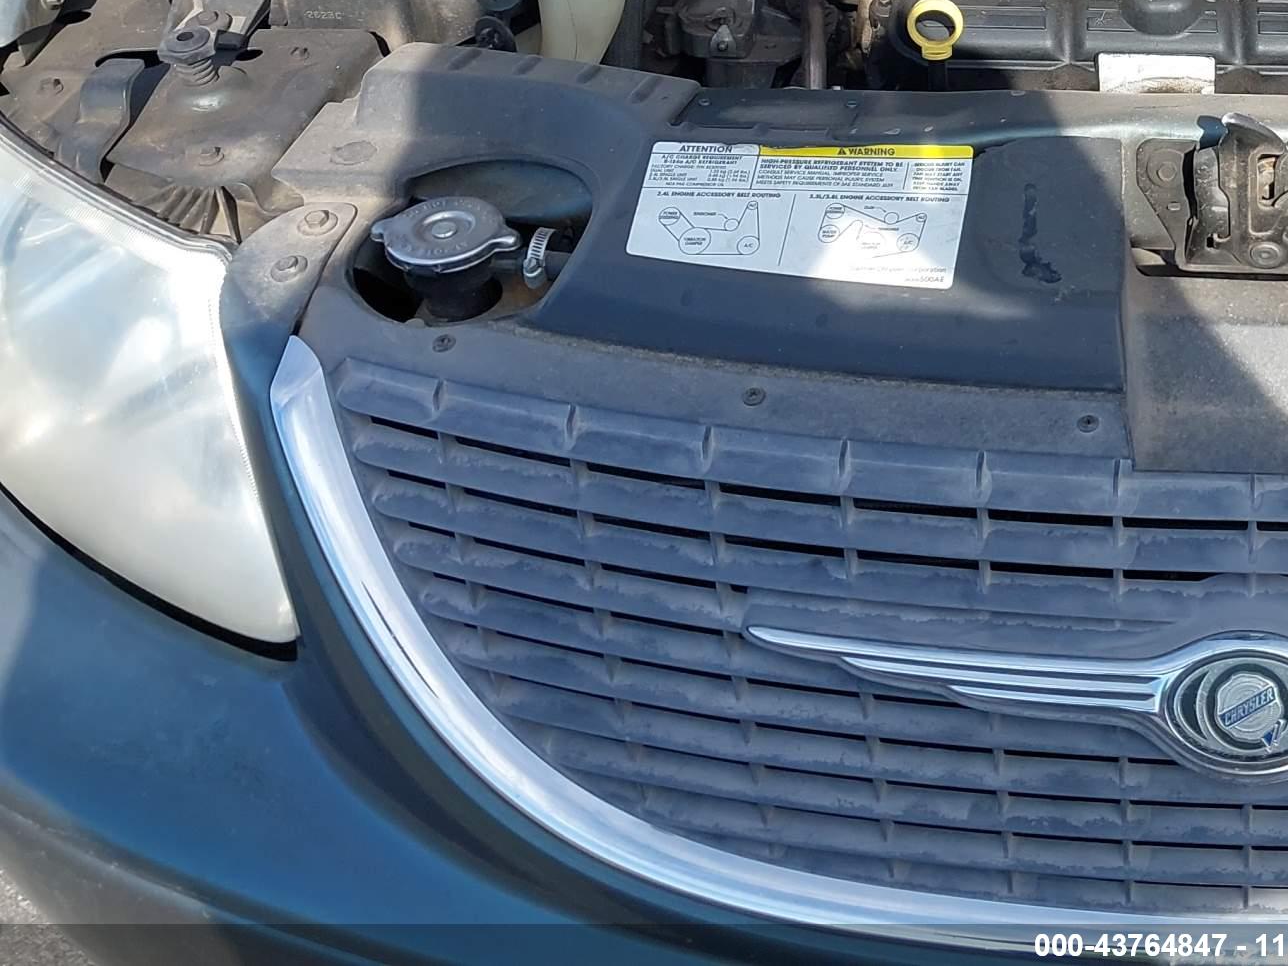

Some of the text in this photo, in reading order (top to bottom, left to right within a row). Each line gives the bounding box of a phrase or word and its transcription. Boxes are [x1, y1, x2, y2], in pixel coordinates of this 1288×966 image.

[680, 144, 733, 154] ATTENTION
[848, 148, 896, 156] WARNING
[1224, 686, 1275, 726] CHRYSLER
